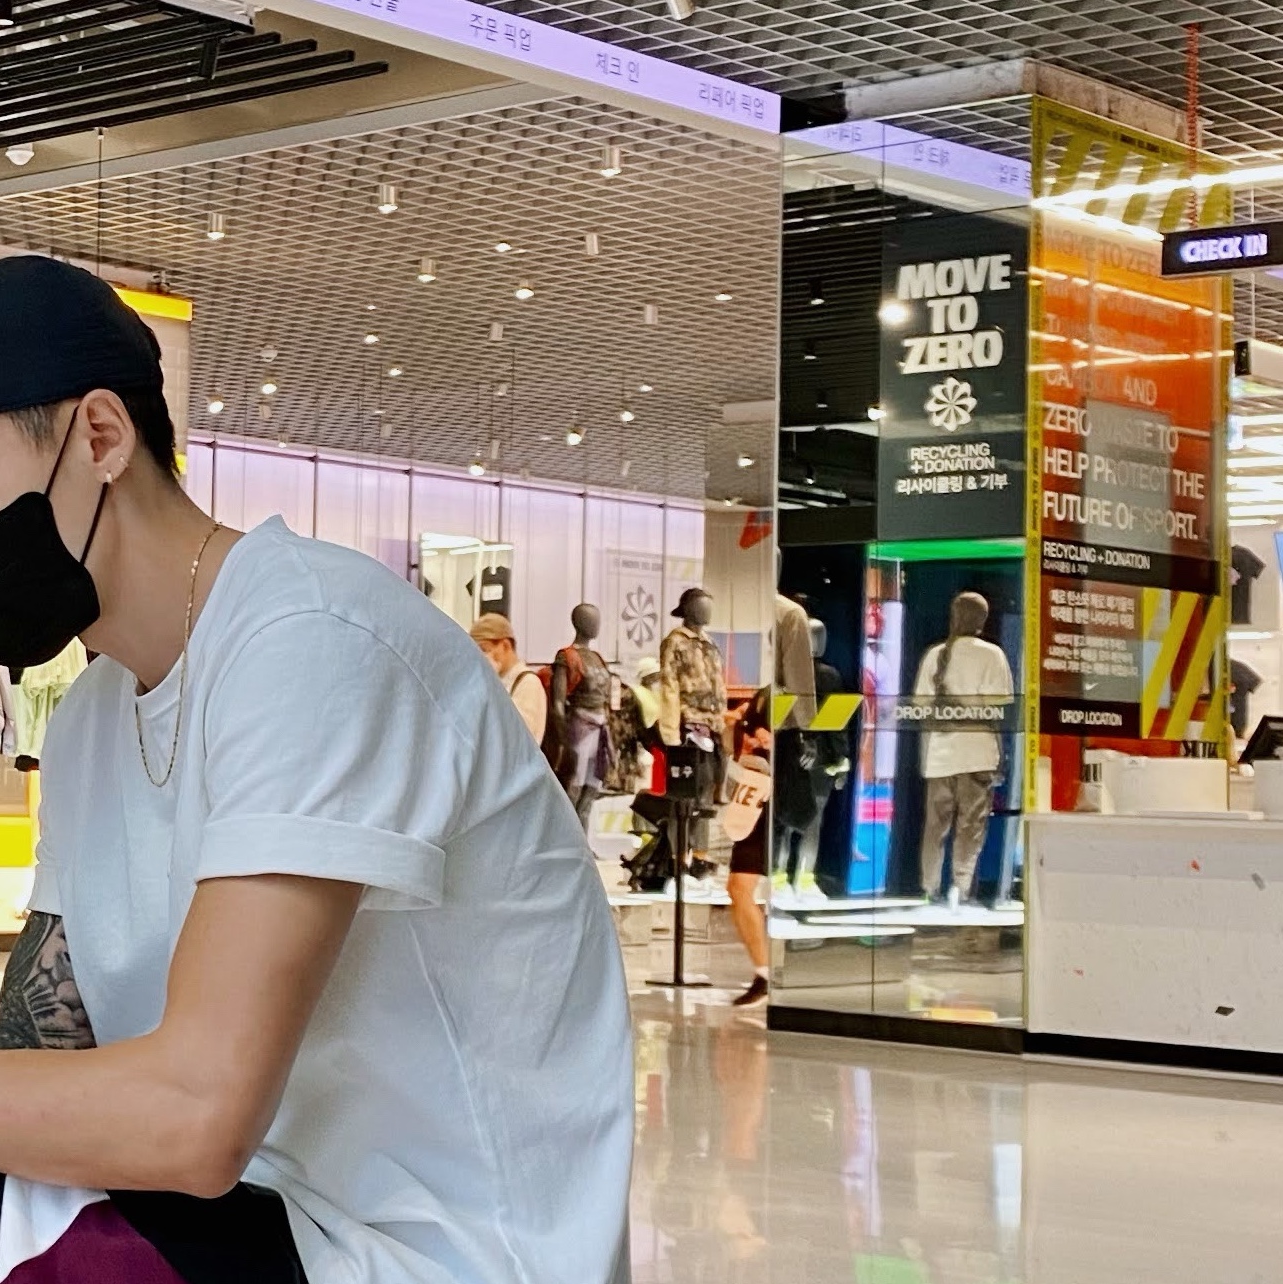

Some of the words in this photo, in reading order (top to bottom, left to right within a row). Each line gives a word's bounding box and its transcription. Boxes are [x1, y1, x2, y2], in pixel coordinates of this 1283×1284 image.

[470, 13, 498, 42] 주문
[504, 23, 531, 51] 픽업
[596, 52, 621, 75] 체크
[628, 61, 639, 83] 인
[698, 83, 736, 112] 리페어
[741, 93, 764, 119] 픽업
[1181, 236, 1242, 263] CHECK
[1243, 234, 1267, 257] IN
[897, 254, 1011, 300] MOVE
[927, 295, 979, 333] TO
[901, 330, 1003, 375] ZERO
[1123, 375, 1157, 406] AND
[1043, 401, 1091, 437] ZERO
[1157, 424, 1179, 453] TO
[910, 442, 991, 461] RECYCLING
[966, 475, 978, 490] &
[981, 473, 1009, 490] 기부
[1044, 446, 1089, 479] HELP
[1093, 454, 1171, 492] PROTECT
[1173, 469, 1205, 499] THE
[1043, 491, 1112, 527] FUTURE
[1116, 502, 1138, 531] OF
[1143, 508, 1198, 539] SPORT.
[1043, 541, 1096, 563] RECYCLING
[1105, 551, 1151, 570] DONATION
[895, 706, 932, 720] DROP
[935, 706, 1004, 720] LOCATION
[1060, 709, 1084, 724] DROP
[1085, 710, 1122, 726] LOCATION
